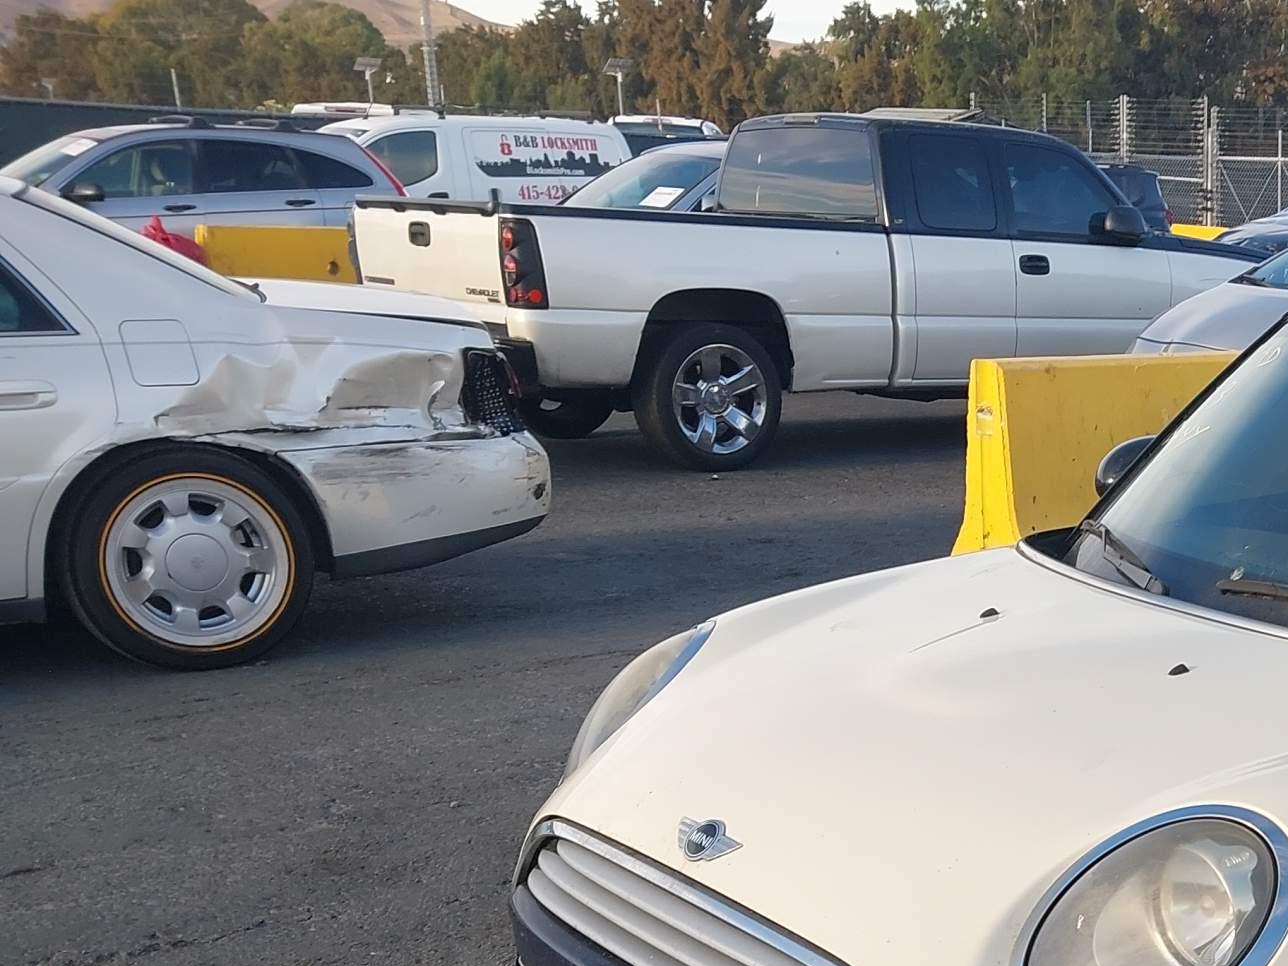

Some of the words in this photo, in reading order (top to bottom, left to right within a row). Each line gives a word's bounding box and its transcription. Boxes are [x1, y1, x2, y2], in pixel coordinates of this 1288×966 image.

[513, 134, 538, 148] B&B
[541, 136, 598, 151] LOCKSMITH
[690, 830, 714, 848] MINI
